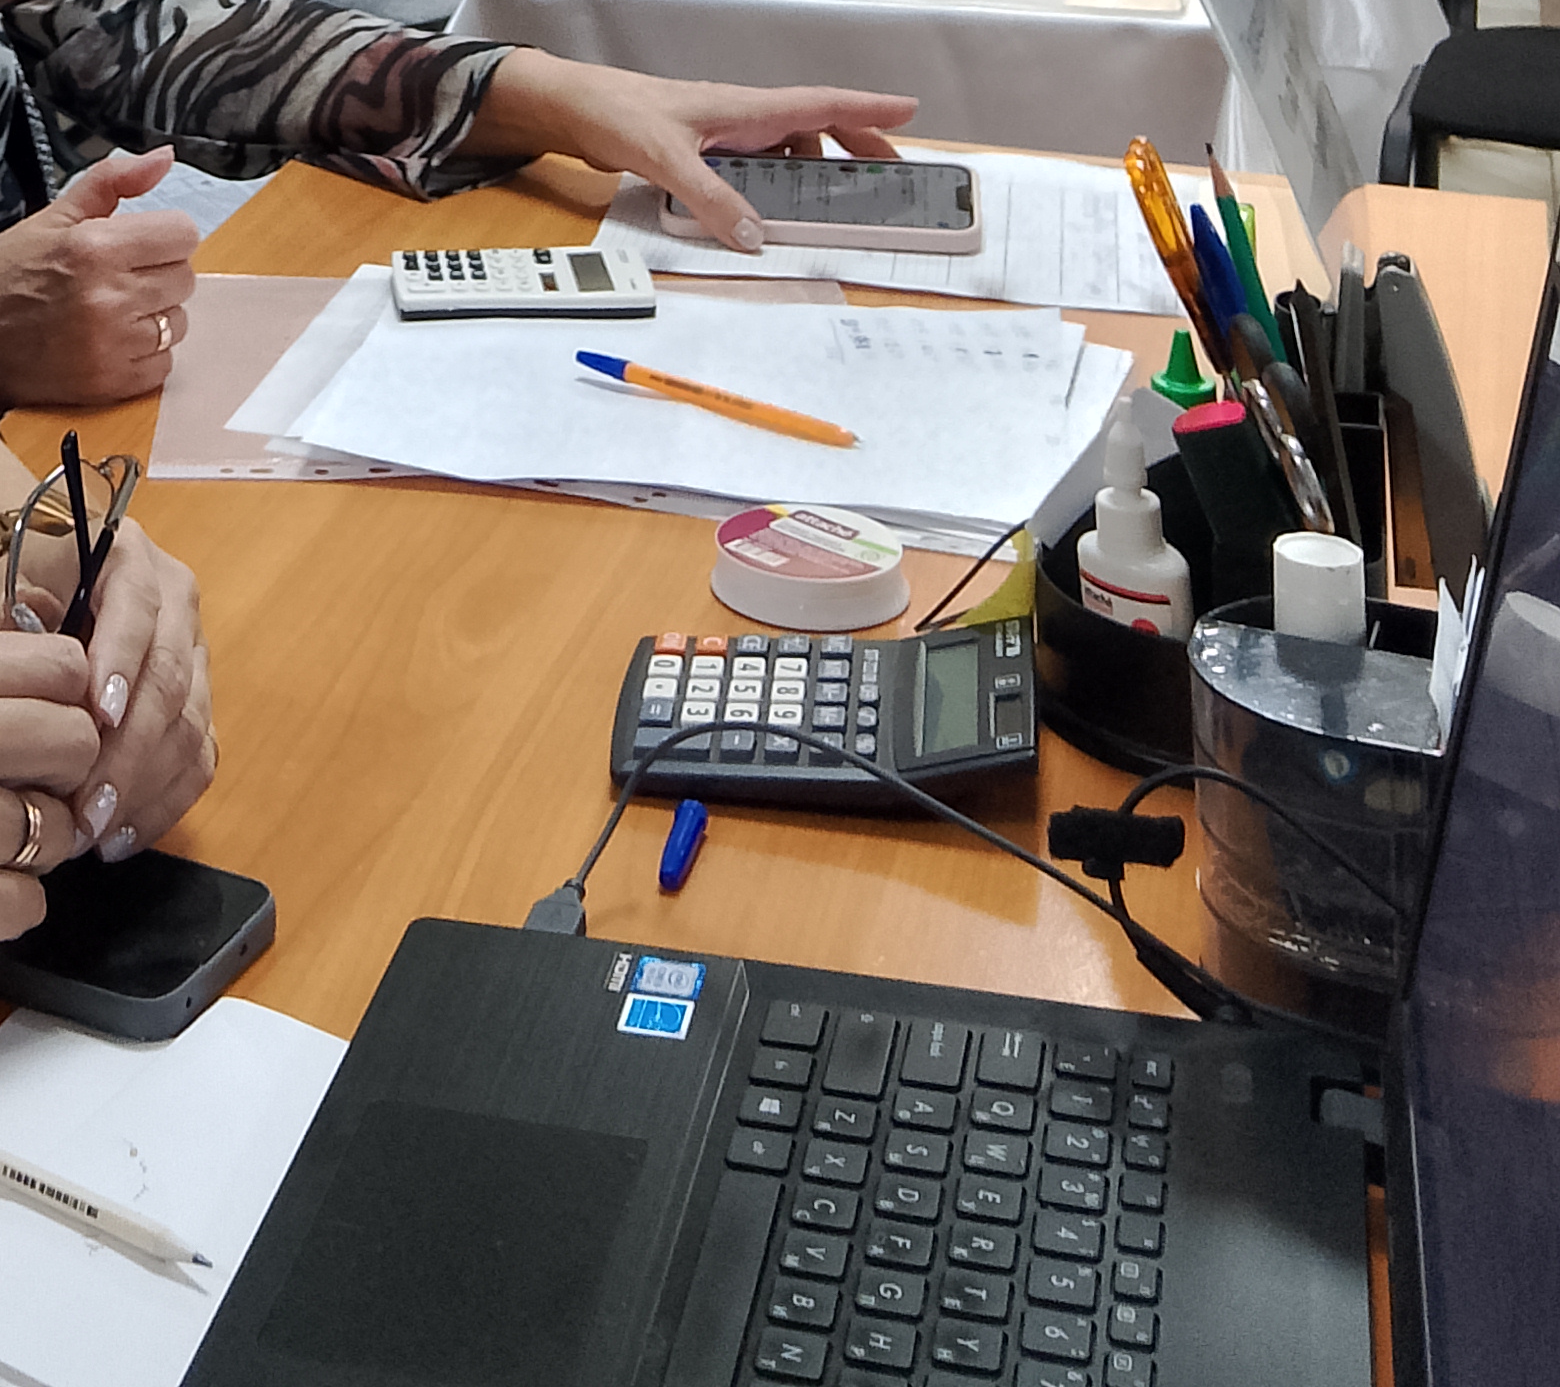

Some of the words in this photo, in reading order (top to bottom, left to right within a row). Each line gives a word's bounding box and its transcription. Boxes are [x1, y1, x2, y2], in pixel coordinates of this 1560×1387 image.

[739, 662, 761, 672] 4
[780, 663, 802, 673] 7
[691, 684, 714, 694] 2
[734, 684, 757, 694] 5
[776, 685, 800, 695] 8
[686, 706, 709, 717] 3
[729, 708, 753, 718] 6
[773, 709, 797, 719] 9
[607, 953, 633, 993] HDMI
[914, 1100, 935, 1113] A
[991, 1100, 1015, 1116] Q
[835, 1109, 856, 1124] Z
[1066, 1133, 1090, 1150] 2
[906, 1143, 929, 1157] S
[986, 1144, 1008, 1162] W
[825, 1153, 846, 1168] X
[1061, 1179, 1085, 1194] 3
[897, 1187, 920, 1203] D
[977, 1189, 1001, 1205] E
[813, 1198, 837, 1214] C
[1057, 1226, 1079, 1241] 4
[889, 1234, 912, 1250] F
[971, 1235, 995, 1252] R
[805, 1246, 827, 1261] V
[1050, 1274, 1075, 1290] 5
[879, 1282, 903, 1301] G
[964, 1286, 988, 1302] T
[792, 1293, 815, 1310] B
[868, 1331, 893, 1350] H
[1044, 1325, 1070, 1341] 6
[780, 1342, 804, 1363] N
[956, 1337, 980, 1353] Y
